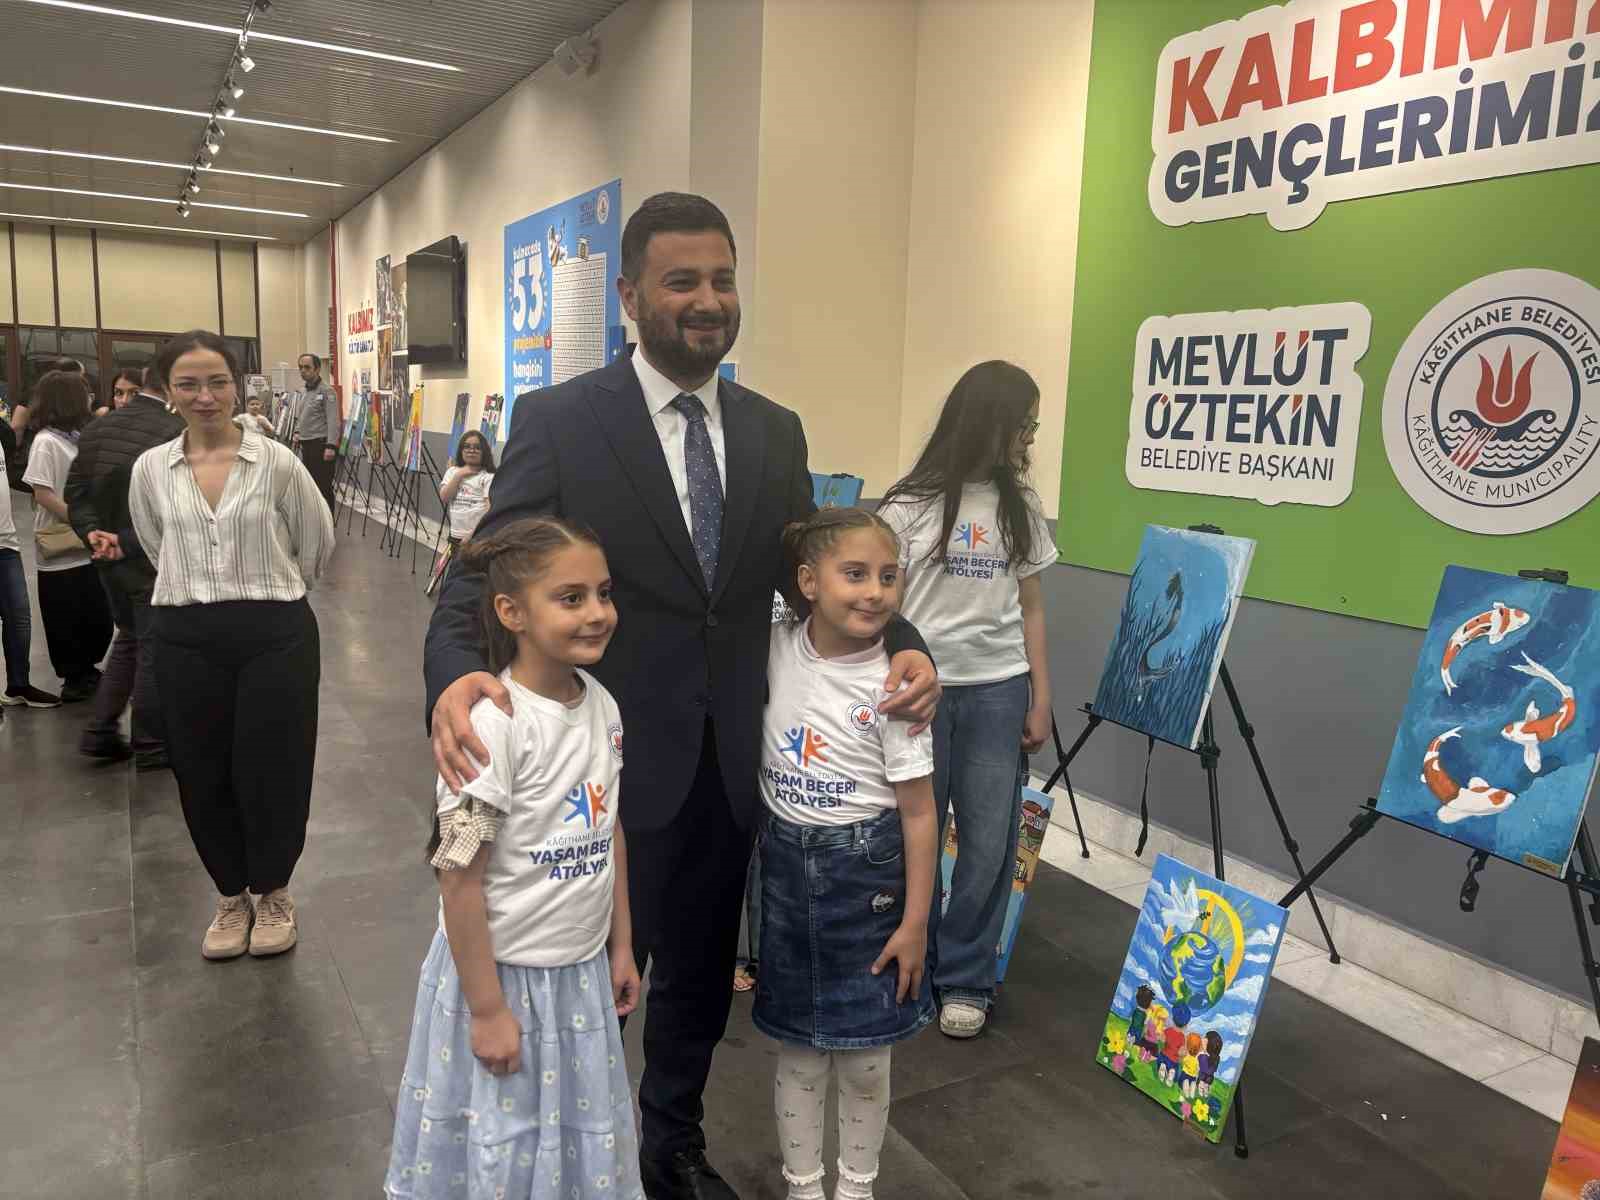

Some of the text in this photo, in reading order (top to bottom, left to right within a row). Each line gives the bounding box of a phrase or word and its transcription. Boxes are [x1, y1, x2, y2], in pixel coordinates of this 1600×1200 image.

[512, 254, 544, 331] 53
[1420, 306, 1512, 384] KÂĞITHANE
[1140, 445, 1334, 481] BELEDİYE BAŞKANI
[1412, 414, 1598, 499] KÂĞITHANE MUNICIPALITY
[763, 766, 802, 789] YAŞAM
[775, 787, 842, 808] ATÖLYESİ
[529, 844, 588, 865] YAŞAM
